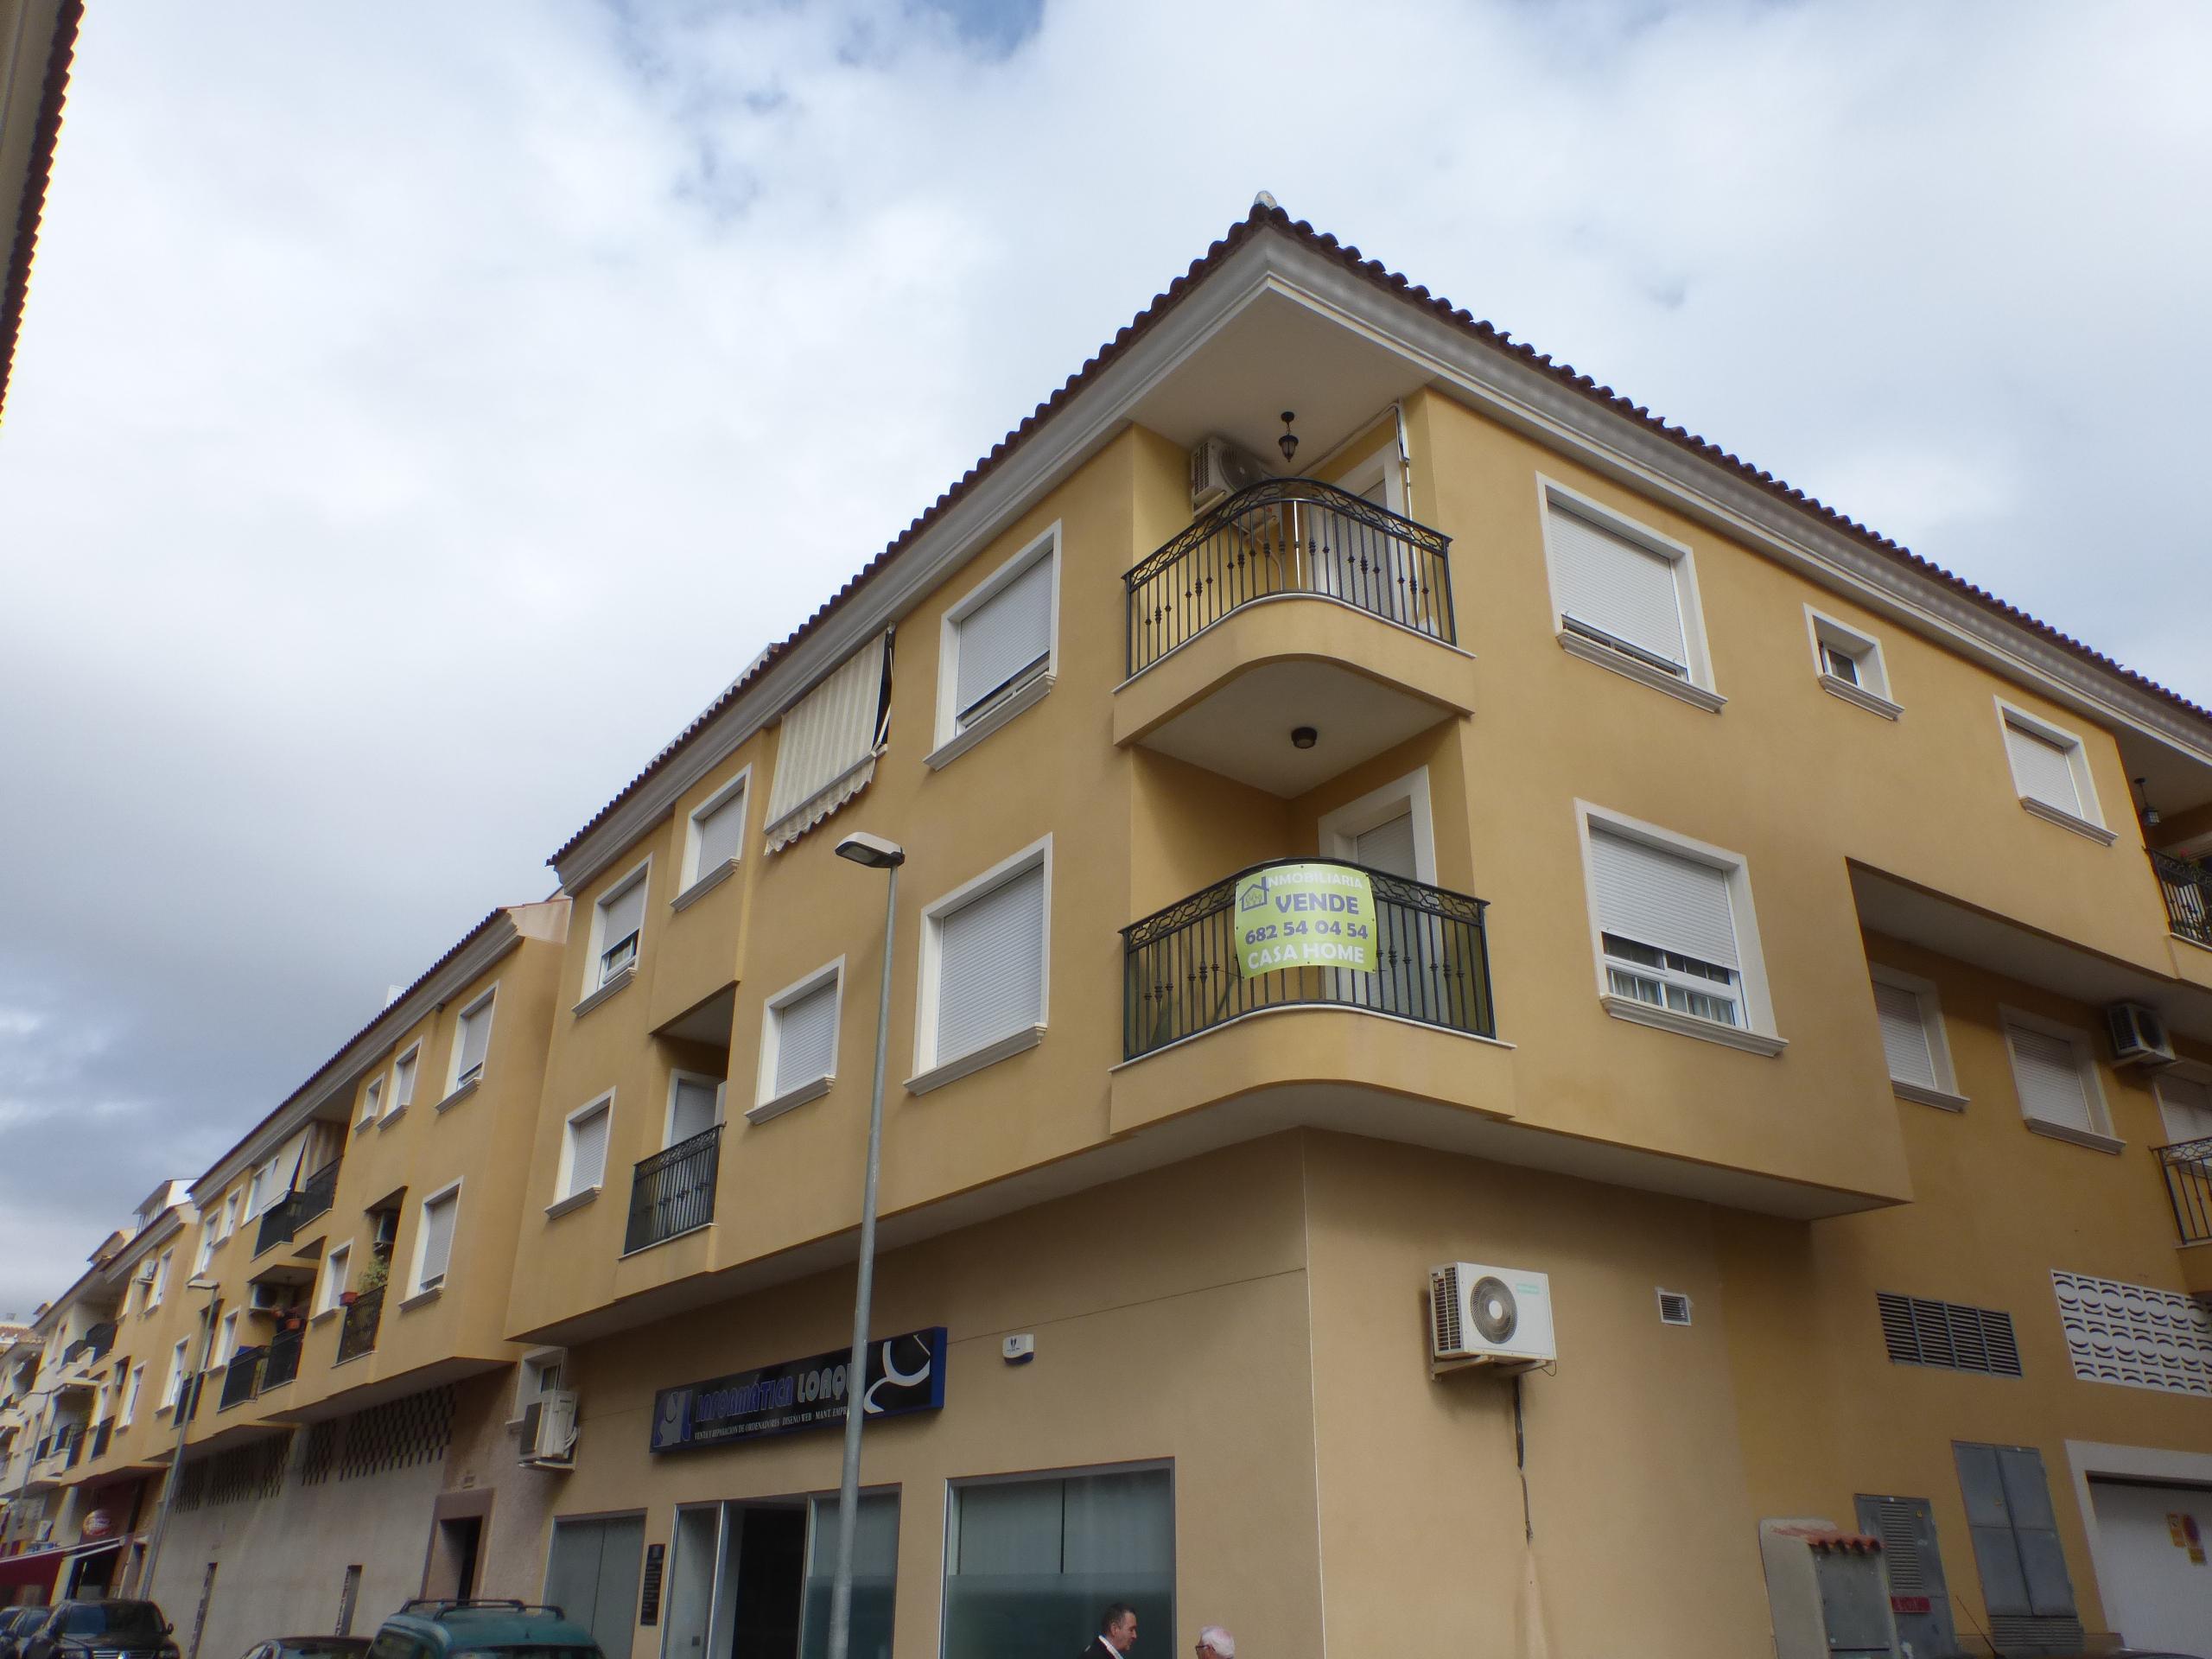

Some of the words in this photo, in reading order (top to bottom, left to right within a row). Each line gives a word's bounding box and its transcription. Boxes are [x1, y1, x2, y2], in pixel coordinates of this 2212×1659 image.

[1275, 893, 1359, 915] VENDE
[1245, 925, 1277, 945] 682
[1283, 919, 1308, 937] 54
[1314, 919, 1341, 935] 04
[1347, 923, 1368, 940] 54
[1248, 944, 1298, 969] CASA
[1303, 943, 1364, 964] HOME
[801, 1412, 812, 1422] WEB
